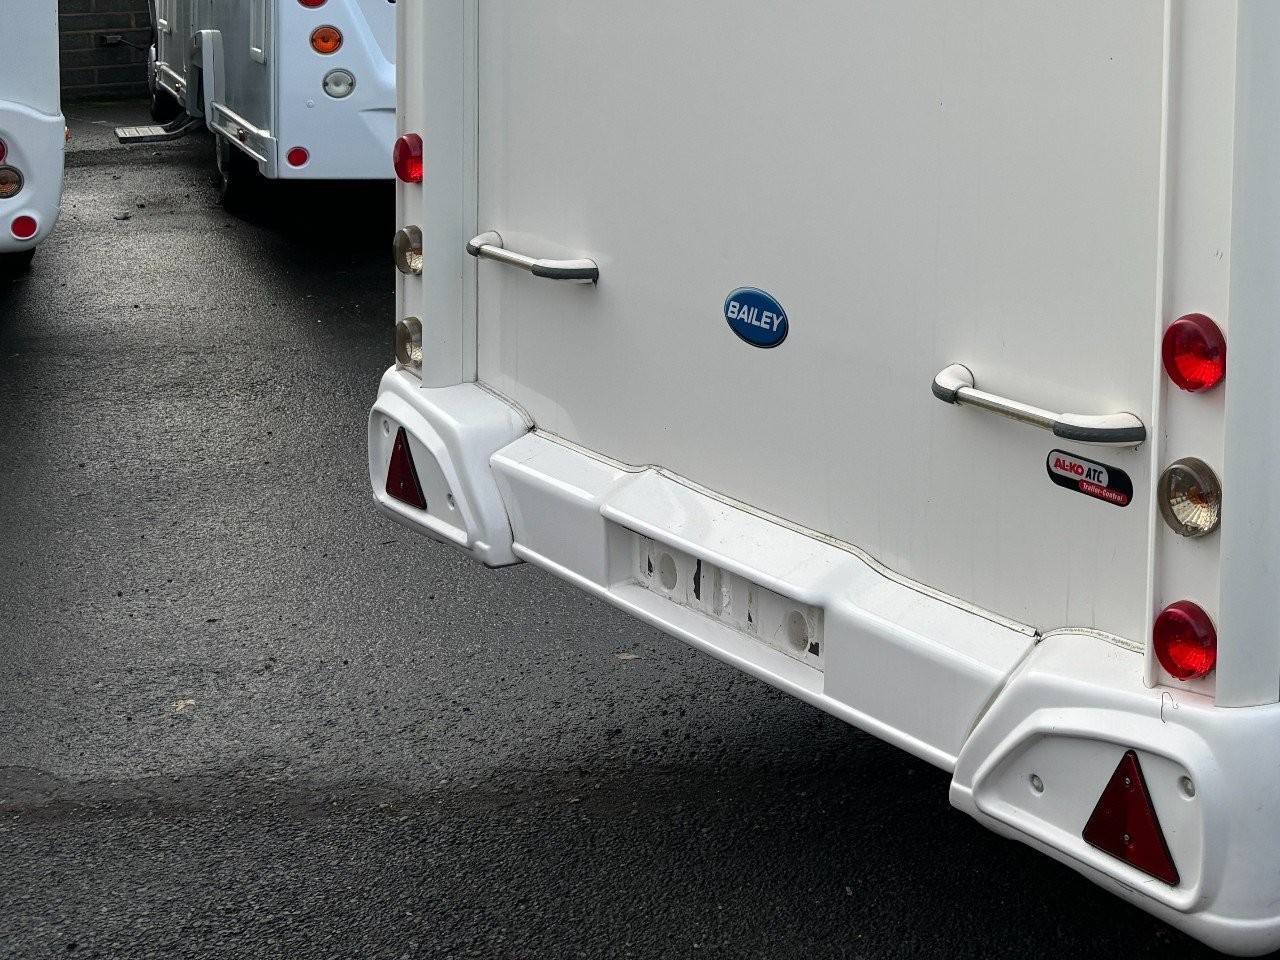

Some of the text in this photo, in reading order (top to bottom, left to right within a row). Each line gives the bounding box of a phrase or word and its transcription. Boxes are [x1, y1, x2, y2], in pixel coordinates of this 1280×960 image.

[728, 301, 783, 331] BAILEY
[1054, 458, 1103, 483] AL-KO ATC
